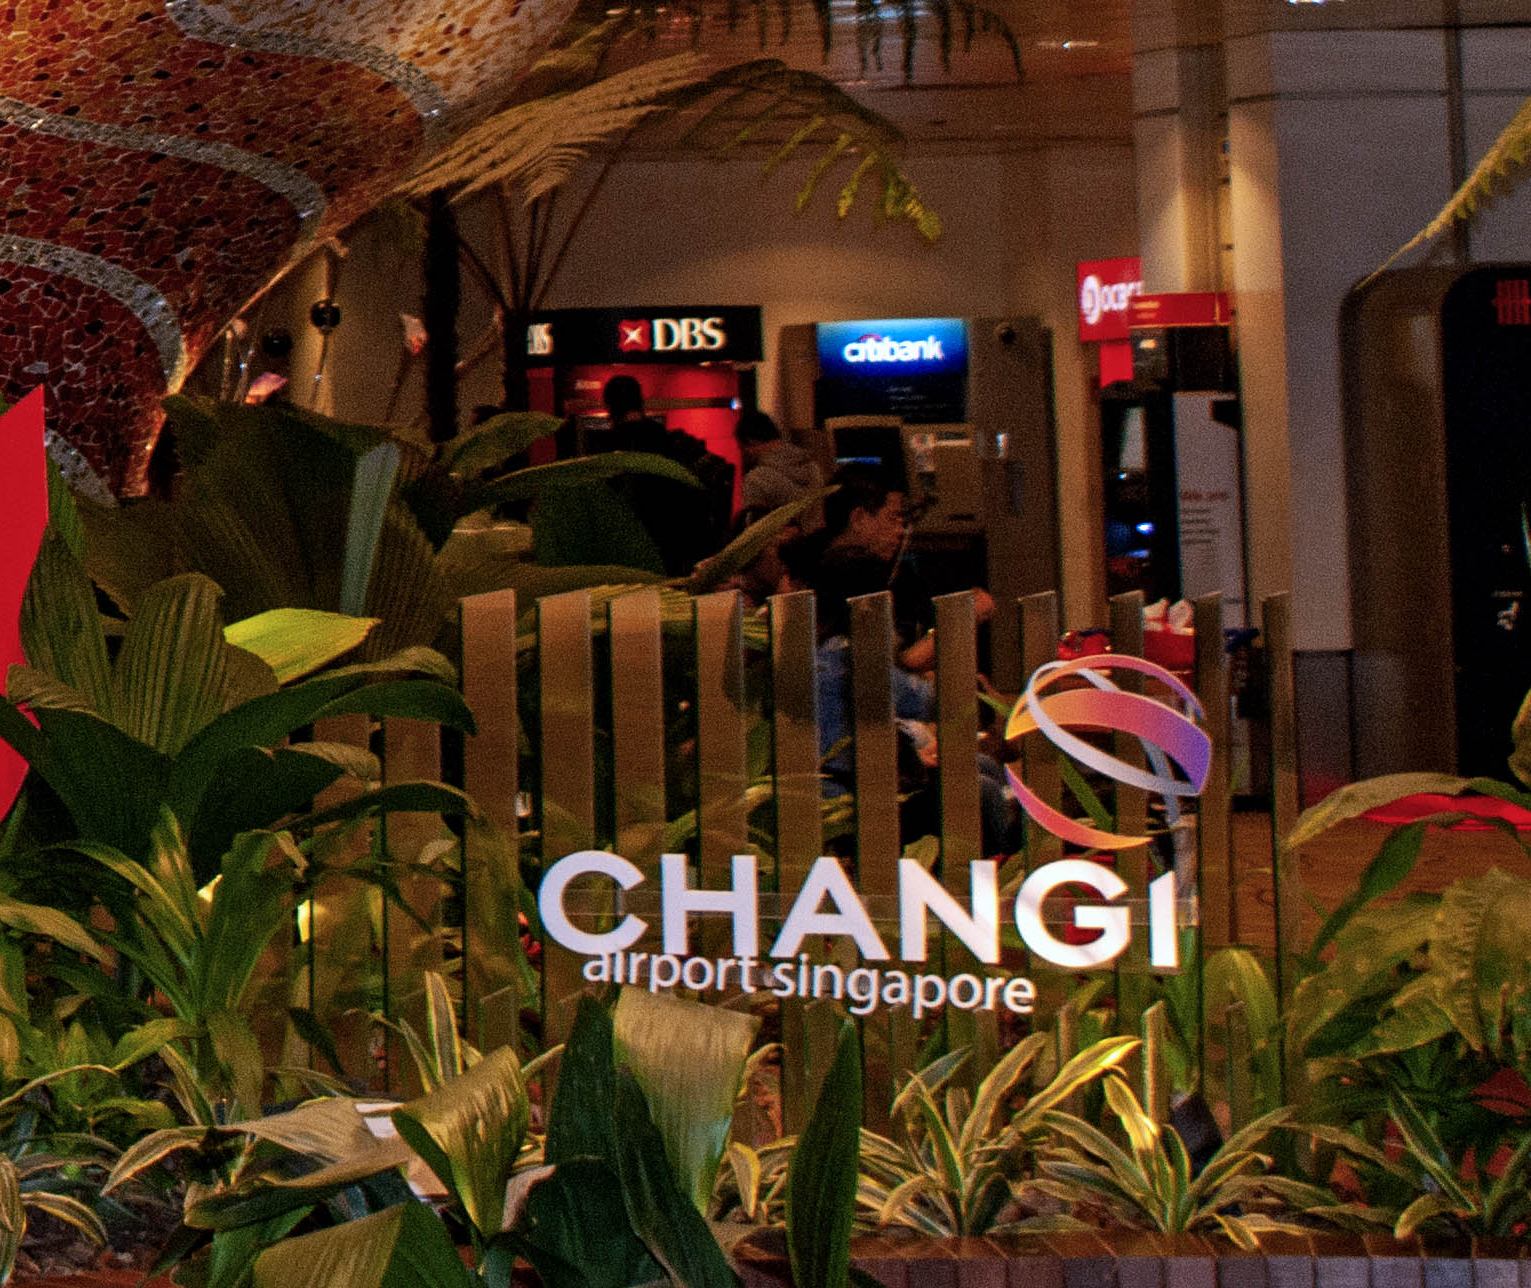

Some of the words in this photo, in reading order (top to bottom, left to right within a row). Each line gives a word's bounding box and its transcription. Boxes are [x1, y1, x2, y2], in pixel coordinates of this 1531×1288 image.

[652, 316, 727, 352] DBS
[843, 334, 944, 362] citibank
[537, 849, 1180, 969] CHANGI
[582, 950, 759, 994] airport
[771, 952, 1038, 1019] singapore
